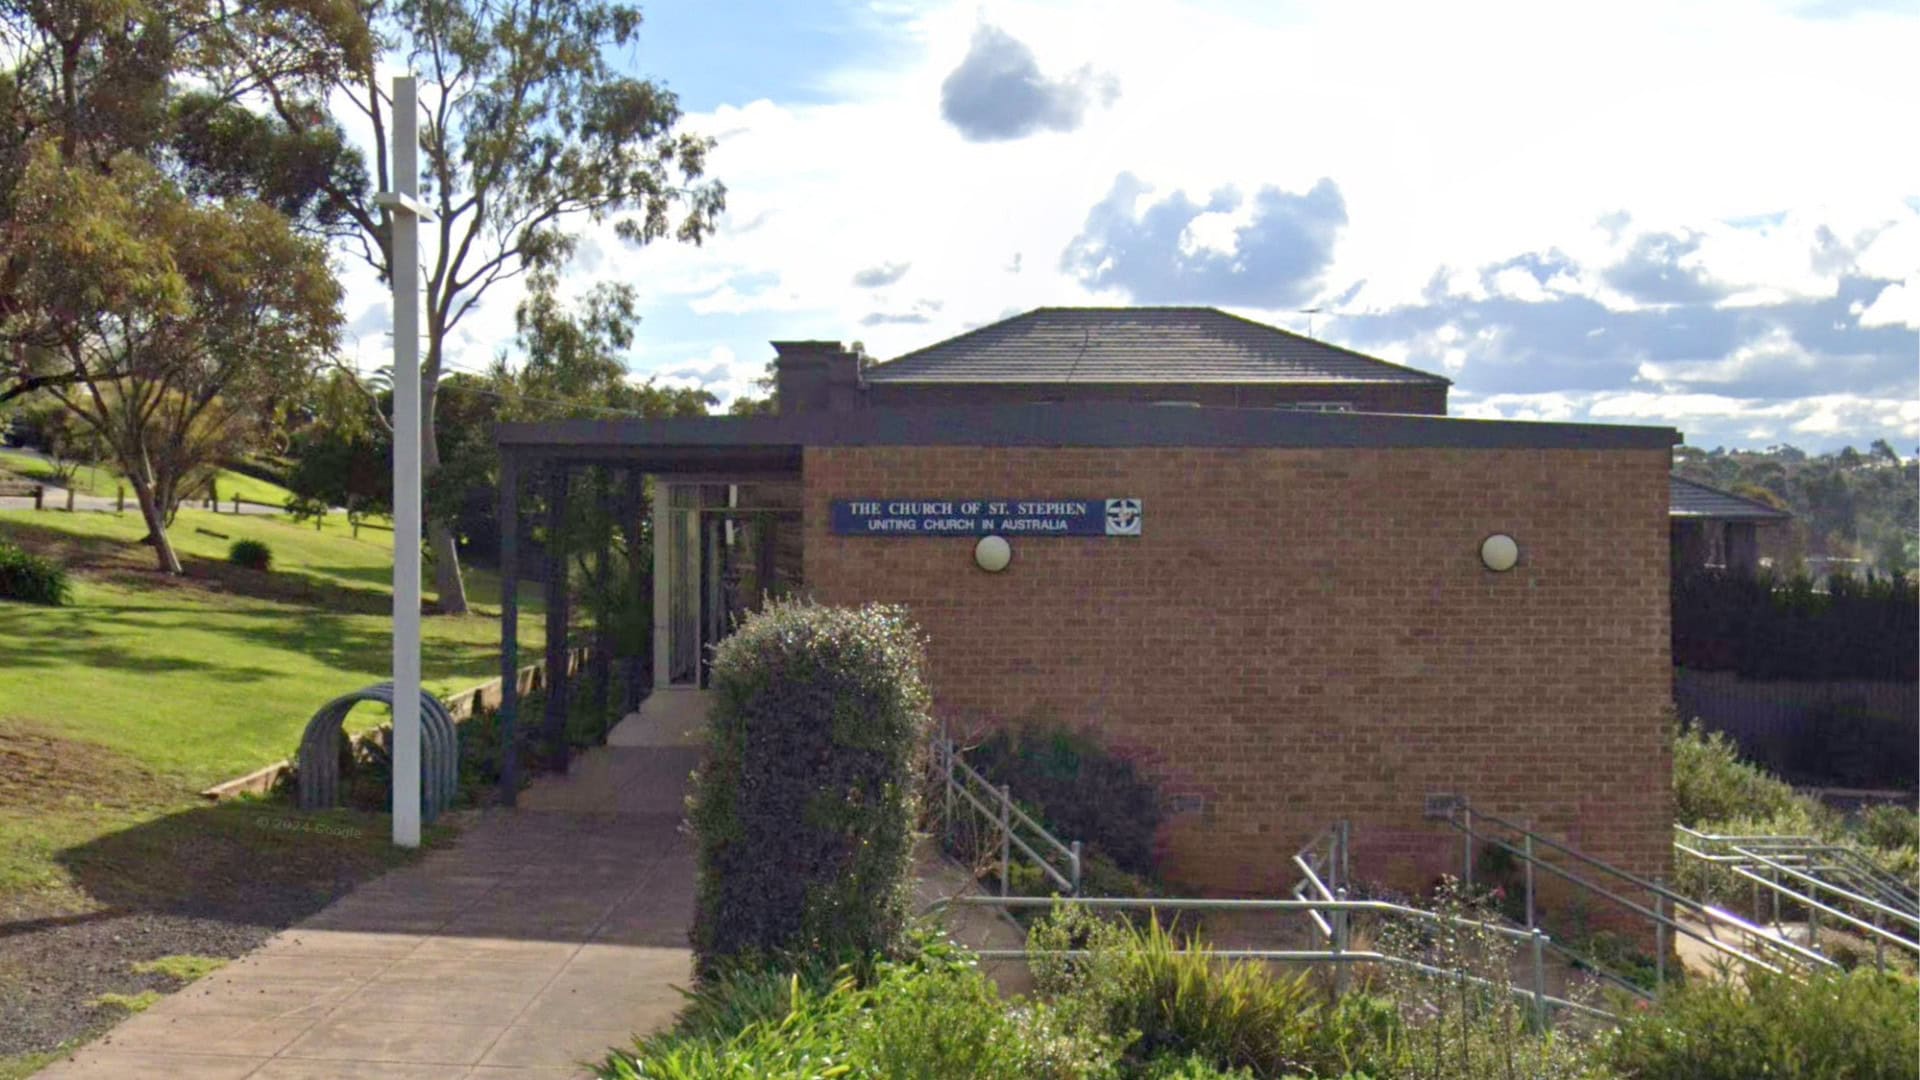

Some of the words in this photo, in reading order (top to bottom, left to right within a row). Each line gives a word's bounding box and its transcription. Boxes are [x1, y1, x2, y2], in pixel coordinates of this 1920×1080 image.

[850, 502, 881, 515] THE
[888, 502, 953, 515] CHURCH
[961, 502, 981, 515] OF
[988, 502, 1010, 515] ST.
[1018, 502, 1087, 515] STEPHEN
[868, 519, 916, 531] UNITING
[924, 519, 974, 531] CHURCH
[982, 519, 994, 531] IN
[1001, 519, 1068, 531] AUSTRALIA
